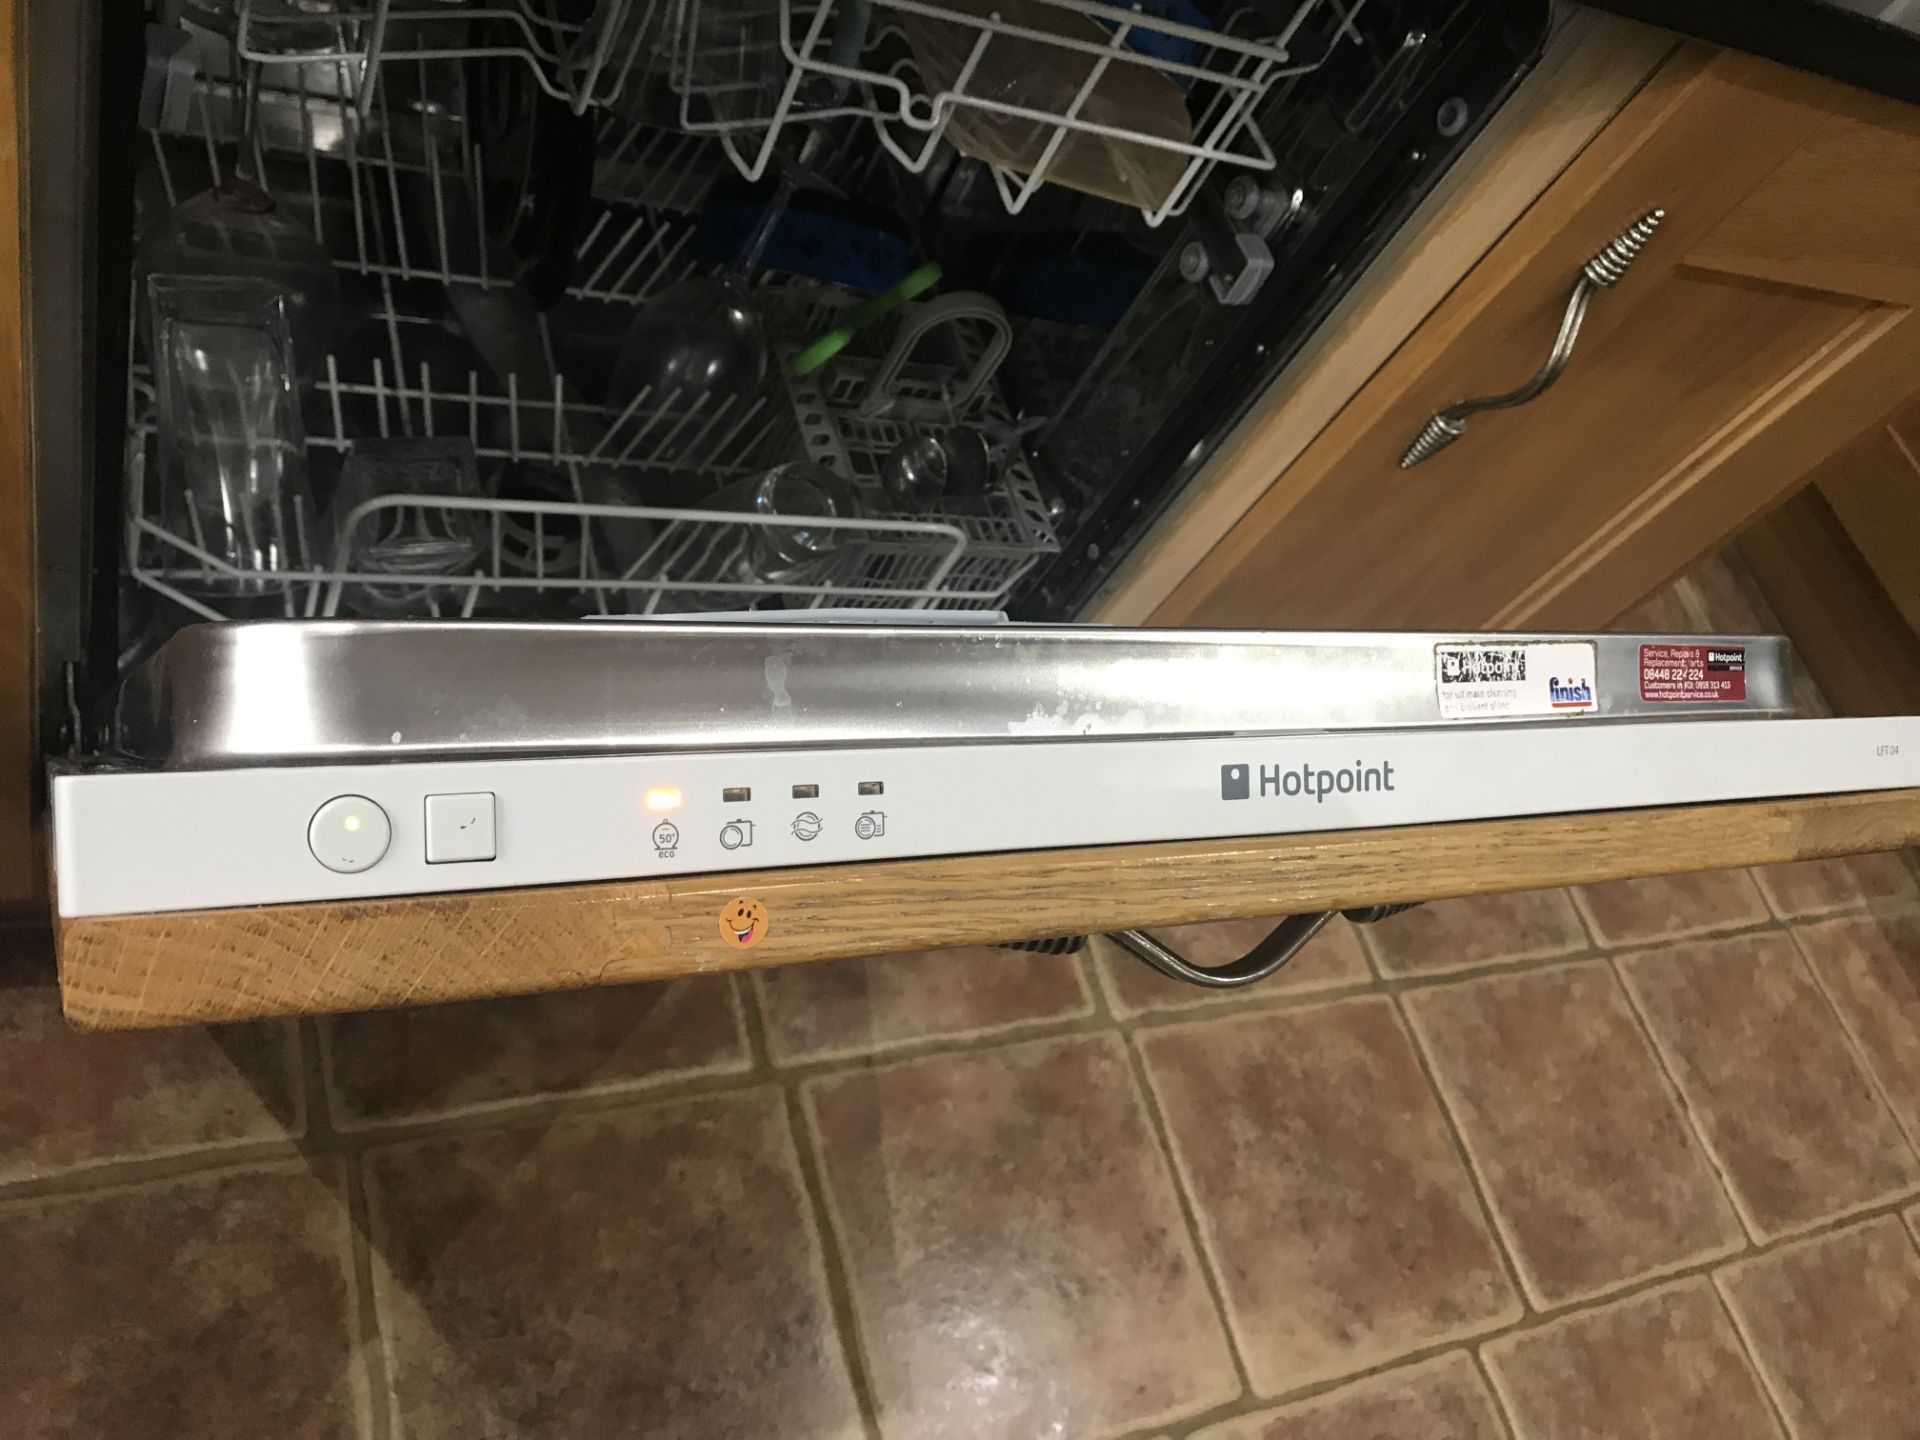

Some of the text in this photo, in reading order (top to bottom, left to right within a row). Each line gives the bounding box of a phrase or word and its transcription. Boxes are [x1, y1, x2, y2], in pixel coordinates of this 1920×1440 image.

[1687, 659, 1704, 667] arts
[1715, 652, 1743, 663] Hotpoint
[1643, 668, 1670, 680] 08448
[1688, 668, 1704, 680] 224
[1549, 676, 1592, 702] finish
[1643, 681, 1676, 690] Customers
[1260, 759, 1395, 804] Hotpoint
[658, 850, 675, 859] eco
